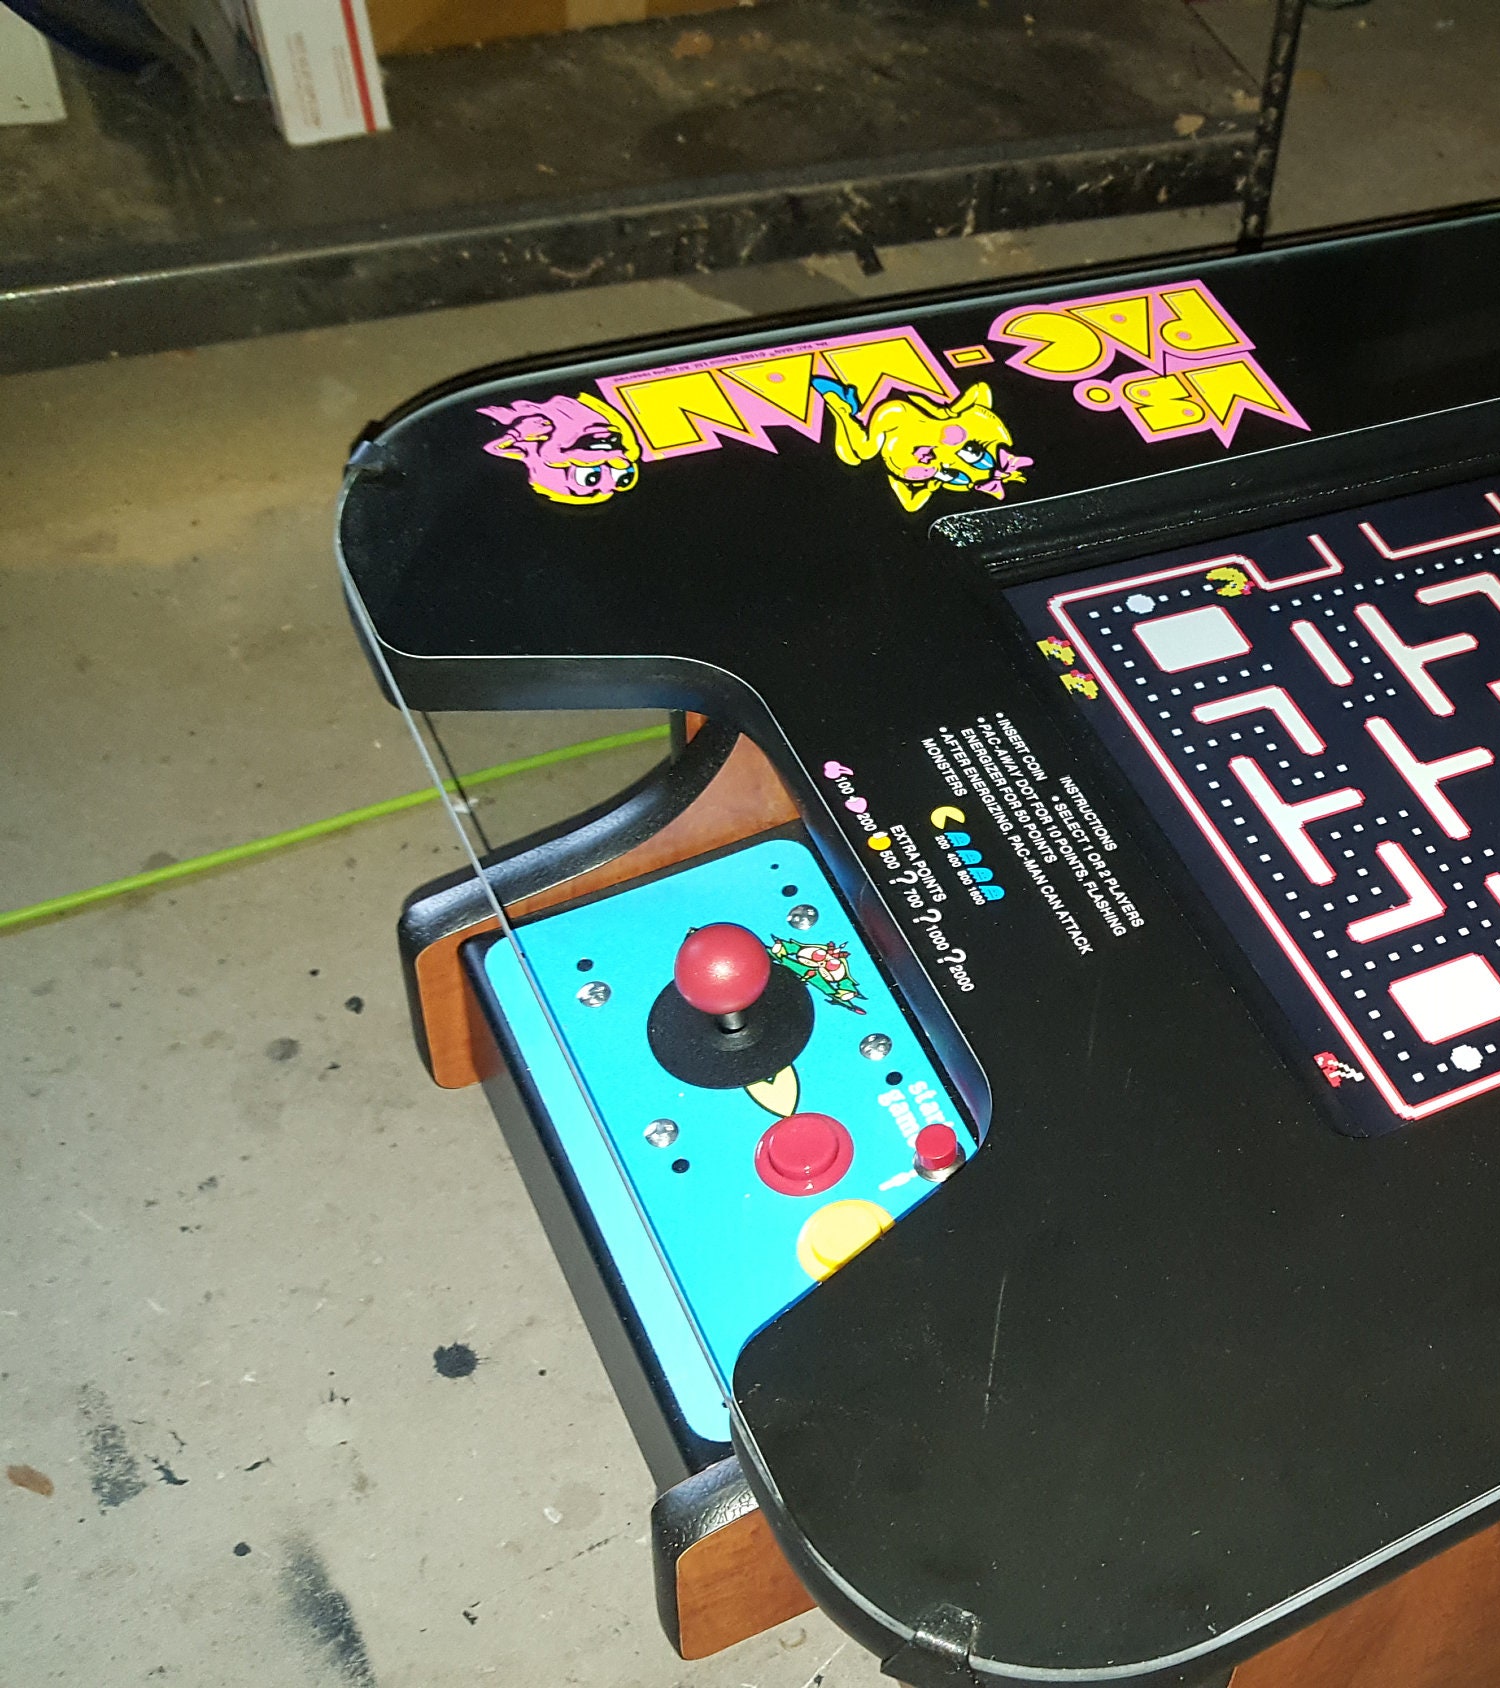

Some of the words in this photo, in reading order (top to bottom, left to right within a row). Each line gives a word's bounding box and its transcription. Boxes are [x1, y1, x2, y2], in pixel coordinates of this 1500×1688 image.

[920, 737, 968, 797] MONSTERS
[977, 724, 1024, 777] PAC-AWAY
[997, 718, 1031, 754] INSERT
[1022, 754, 1048, 782] COIN
[960, 727, 1008, 787] ENERGIZER
[998, 786, 1023, 810] FOR
[1013, 809, 1031, 823] 50
[1022, 822, 1058, 864] POINTS
[1014, 778, 1040, 801] DOT
[1030, 801, 1054, 825] FOR
[1059, 776, 1118, 852] INSTRUCTIONS
[940, 734, 972, 768] AFTER
[963, 766, 1014, 836] ENERGIZING,
[1007, 834, 1049, 886] PAC-MAN
[1040, 885, 1065, 910] CAN
[1055, 911, 1094, 955] ATTACK
[1046, 824, 1063, 838] 10
[1053, 802, 1091, 843] SELECT
[1082, 844, 1094, 852] 1
[889, 824, 921, 862] EXTRA
[911, 860, 947, 903] POINTS
[934, 834, 951, 850] 200
[946, 853, 962, 868] 400
[1054, 837, 1089, 882] POINTS,
[1087, 852, 1107, 871] OR
[1098, 869, 1112, 879] 2
[834, 778, 854, 795] 100
[856, 812, 878, 832] 200
[879, 849, 901, 870] 500
[903, 887, 924, 909] 700
[925, 924, 950, 951] 1000
[948, 963, 975, 992] 2000
[1082, 880, 1127, 937] FLASHING
[1103, 877, 1145, 928] PLAYERS
